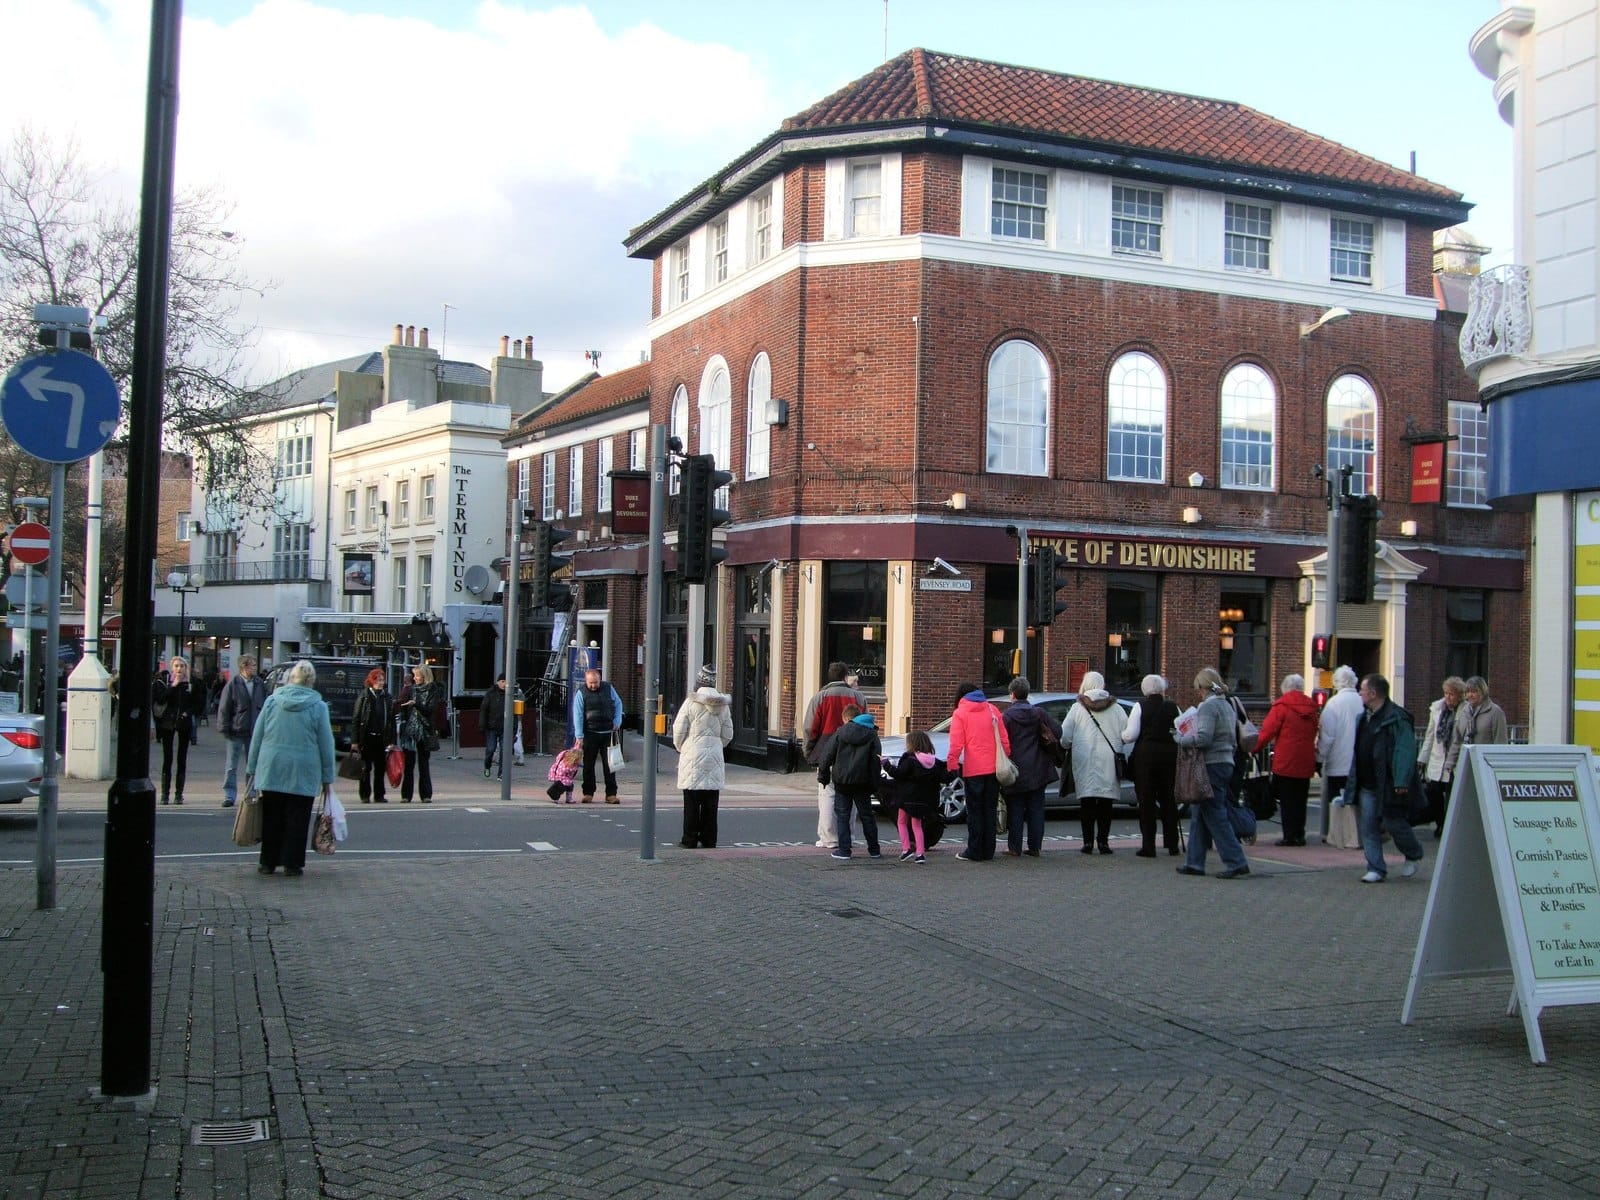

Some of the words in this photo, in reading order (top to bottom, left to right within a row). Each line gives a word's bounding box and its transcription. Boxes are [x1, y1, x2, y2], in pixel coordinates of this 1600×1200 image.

[453, 465, 471, 475] The
[657, 473, 663, 481] 2
[453, 479, 468, 592] TERMINUS
[1084, 540, 1114, 565] OF
[1120, 542, 1256, 572] DEVONSHIRE
[920, 580, 949, 588] PEVENSEY
[952, 581, 970, 589] ROAD
[352, 627, 397, 645] Terminus
[859, 669, 879, 677] ALES
[1501, 784, 1574, 798] TAKEAWAY
[1512, 816, 1552, 832] Sausage
[1553, 816, 1577, 829] Rolls
[1515, 849, 1554, 862] Cornish
[1555, 849, 1588, 862] Pasties
[1520, 883, 1564, 895] Selection
[1565, 882, 1577, 894] of
[1577, 882, 1597, 894] Pies
[1540, 900, 1550, 912] &
[1552, 899, 1586, 912] Pasties
[1536, 939, 1552, 951] To
[1552, 939, 1577, 950] Take
[1554, 959, 1564, 968] or
[1565, 956, 1583, 968] Eat
[1583, 955, 1594, 967] In
